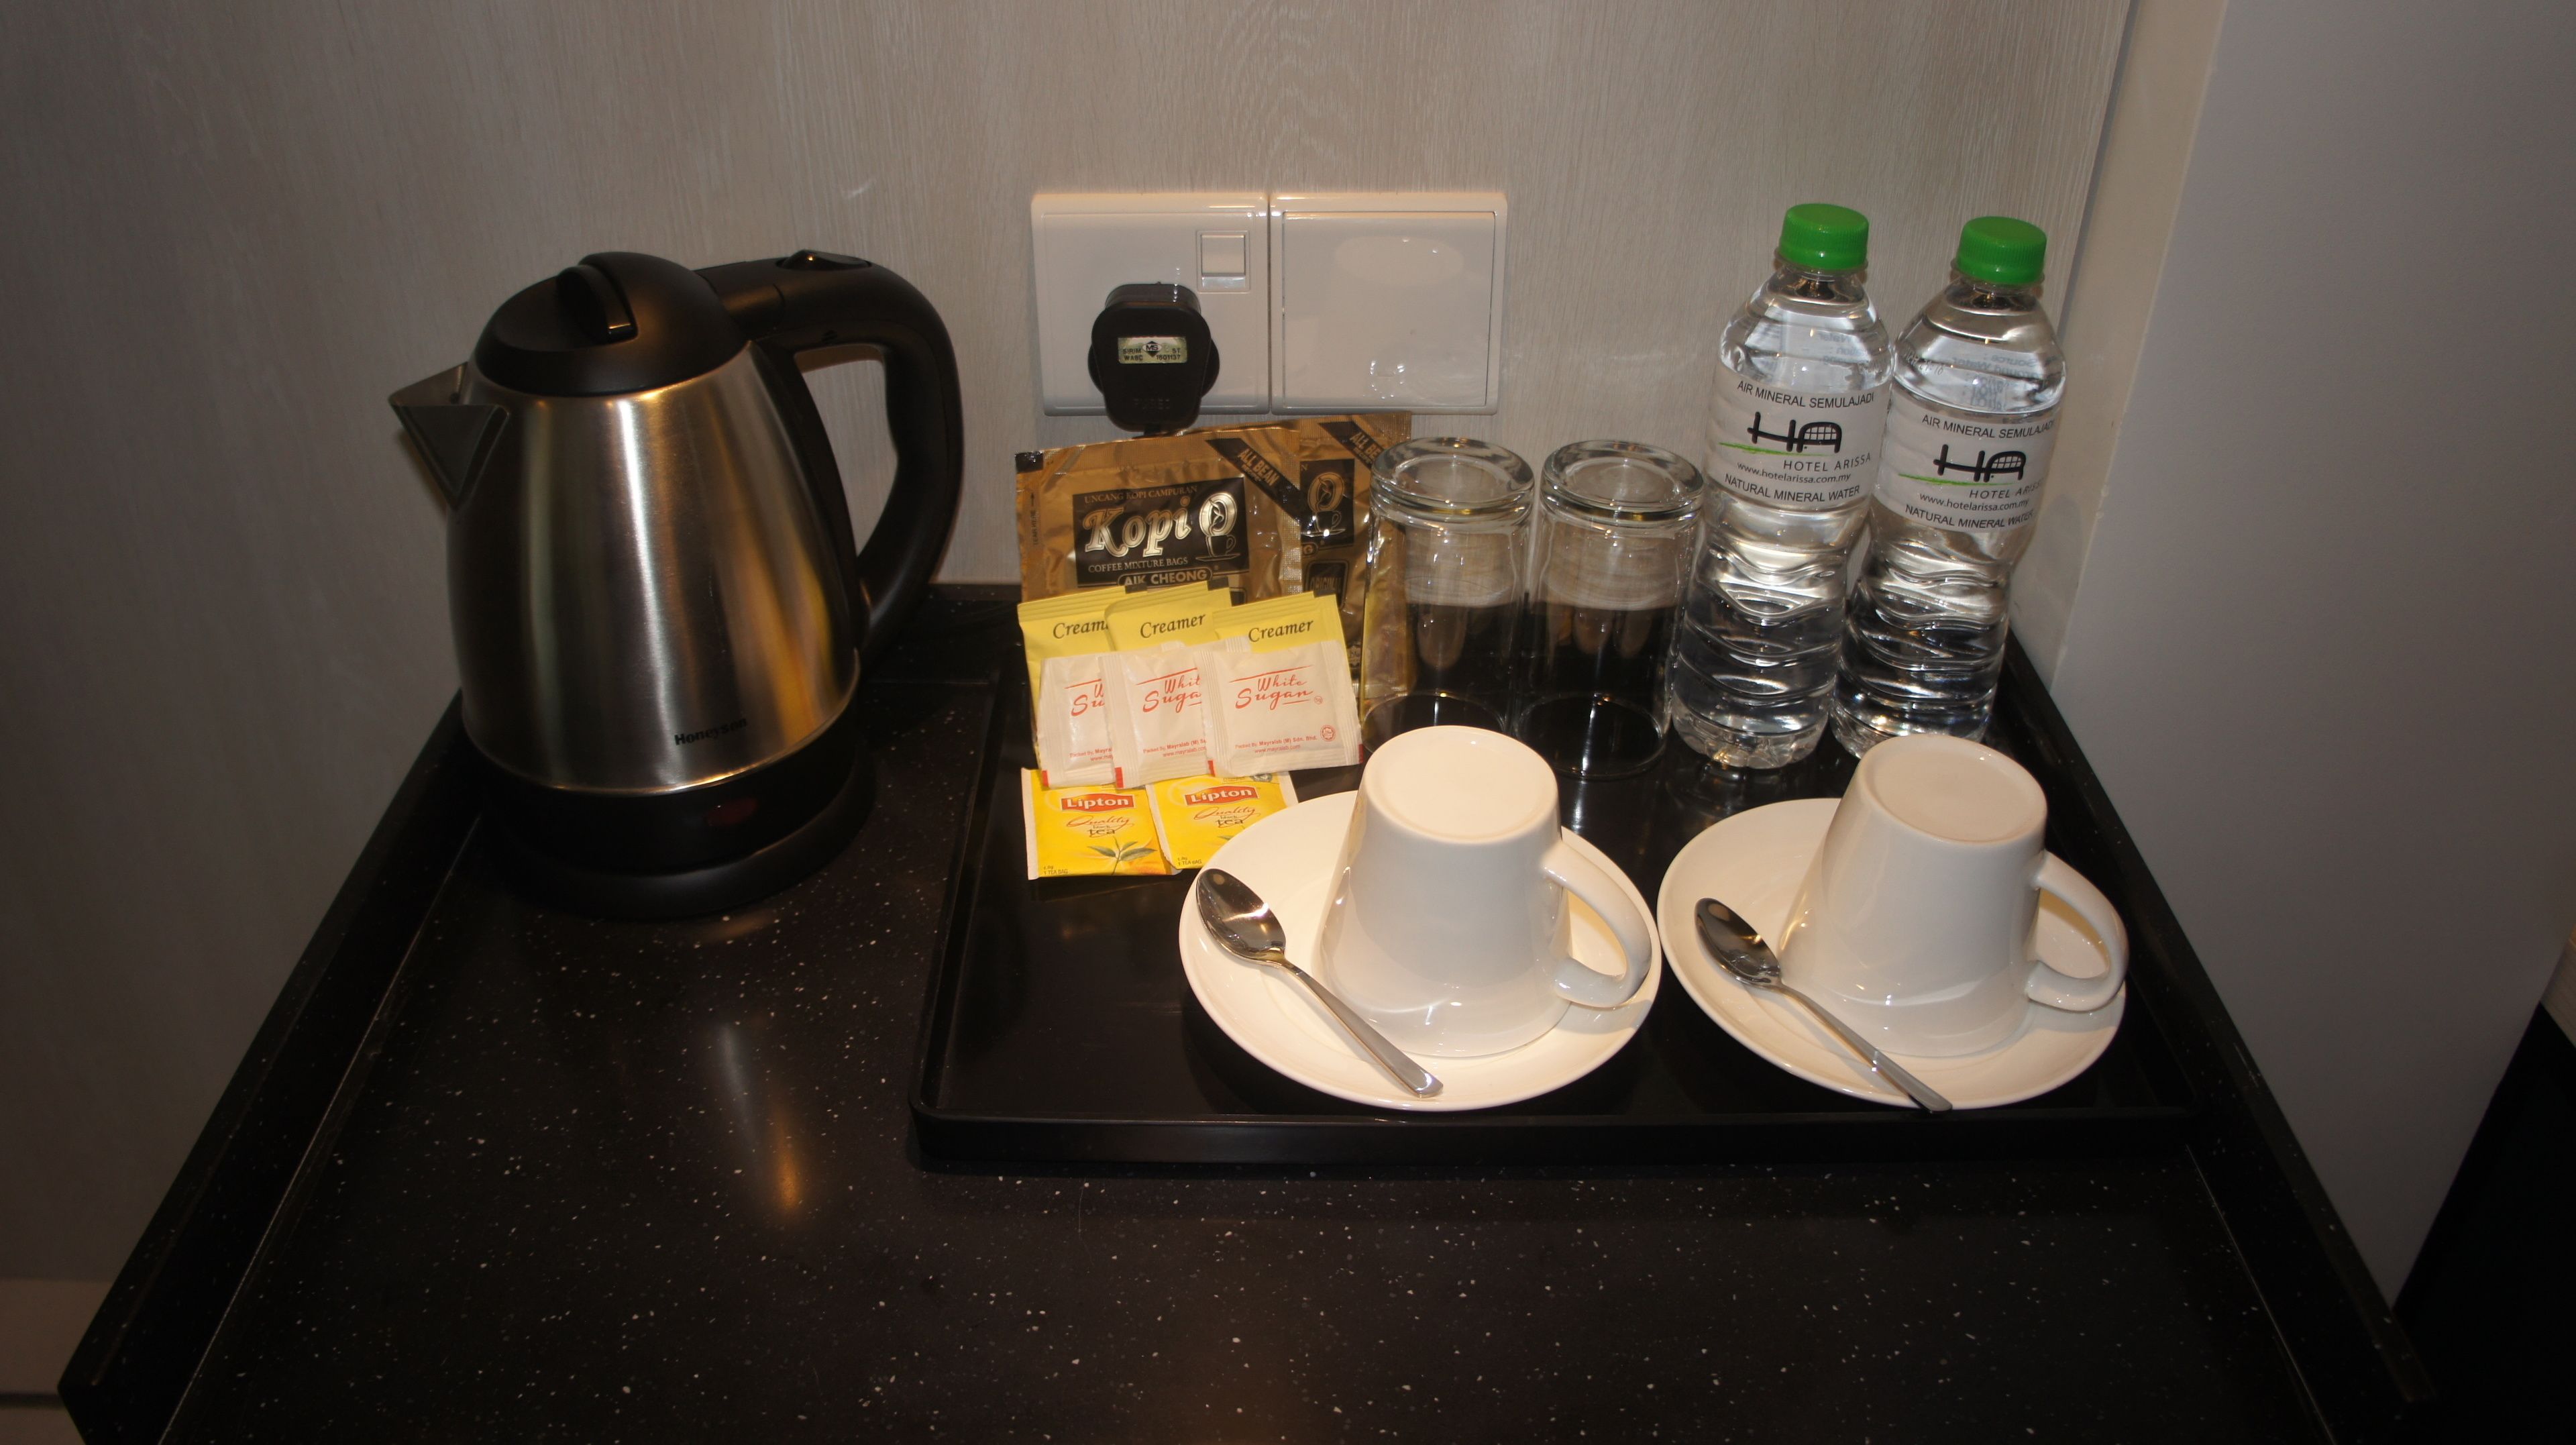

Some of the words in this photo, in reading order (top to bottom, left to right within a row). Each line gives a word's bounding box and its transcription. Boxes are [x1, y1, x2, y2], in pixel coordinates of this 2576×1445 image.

[1737, 380, 1753, 395] AIR
[1755, 387, 1806, 407] MINERAL
[1809, 392, 1875, 409] SEMULAJADI
[1922, 414, 1940, 429] AIR
[1943, 421, 1995, 438] MINERAL
[1349, 432, 1369, 449] ALL
[1364, 443, 1382, 462] BE
[1238, 449, 1256, 467] ALL
[1252, 460, 1280, 486] BEAN
[1783, 460, 1828, 472] HOTEL
[1834, 452, 1871, 472] ARISSA
[1737, 462, 1851, 484] www.hotelarissa.com.my
[1084, 492, 1124, 504] UNCANG
[1126, 490, 1146, 500] KOPI
[1148, 486, 1197, 498] CAMPURAN
[1725, 473, 1771, 498] NATURAL
[1774, 490, 1825, 502] MINERAL
[1828, 485, 1860, 500] WATER
[1969, 489, 2010, 499] HOTEL
[2015, 476, 2046, 496] ARISS
[1919, 492, 2029, 511] www.hotelarissa.com.my
[1082, 496, 1191, 557] Kopi
[1905, 504, 1955, 526] NATURAL
[1957, 517, 2005, 529] MINERAL
[1088, 564, 1122, 573] COFFEE
[1124, 559, 1165, 570] MIXTURE
[1167, 557, 1188, 566] BAGS
[1124, 575, 1146, 585] AIK
[1150, 570, 1208, 584] CHEONG
[1053, 620, 1108, 639] Cream
[1140, 614, 1205, 638] Creamer
[1248, 620, 1313, 642] Creamer
[1164, 674, 1200, 694] Whit
[1257, 674, 1308, 692] White
[1142, 690, 1202, 713] Suga
[1235, 688, 1314, 710] Sugar
[674, 718, 747, 745] Honeyson
[1067, 798, 1129, 809] Lipton
[1191, 788, 1252, 802] Lipton
[1066, 814, 1134, 831] Quality
[1193, 806, 1261, 820] Quality
[1216, 818, 1244, 827] tea
[1088, 828, 1115, 837] tea
